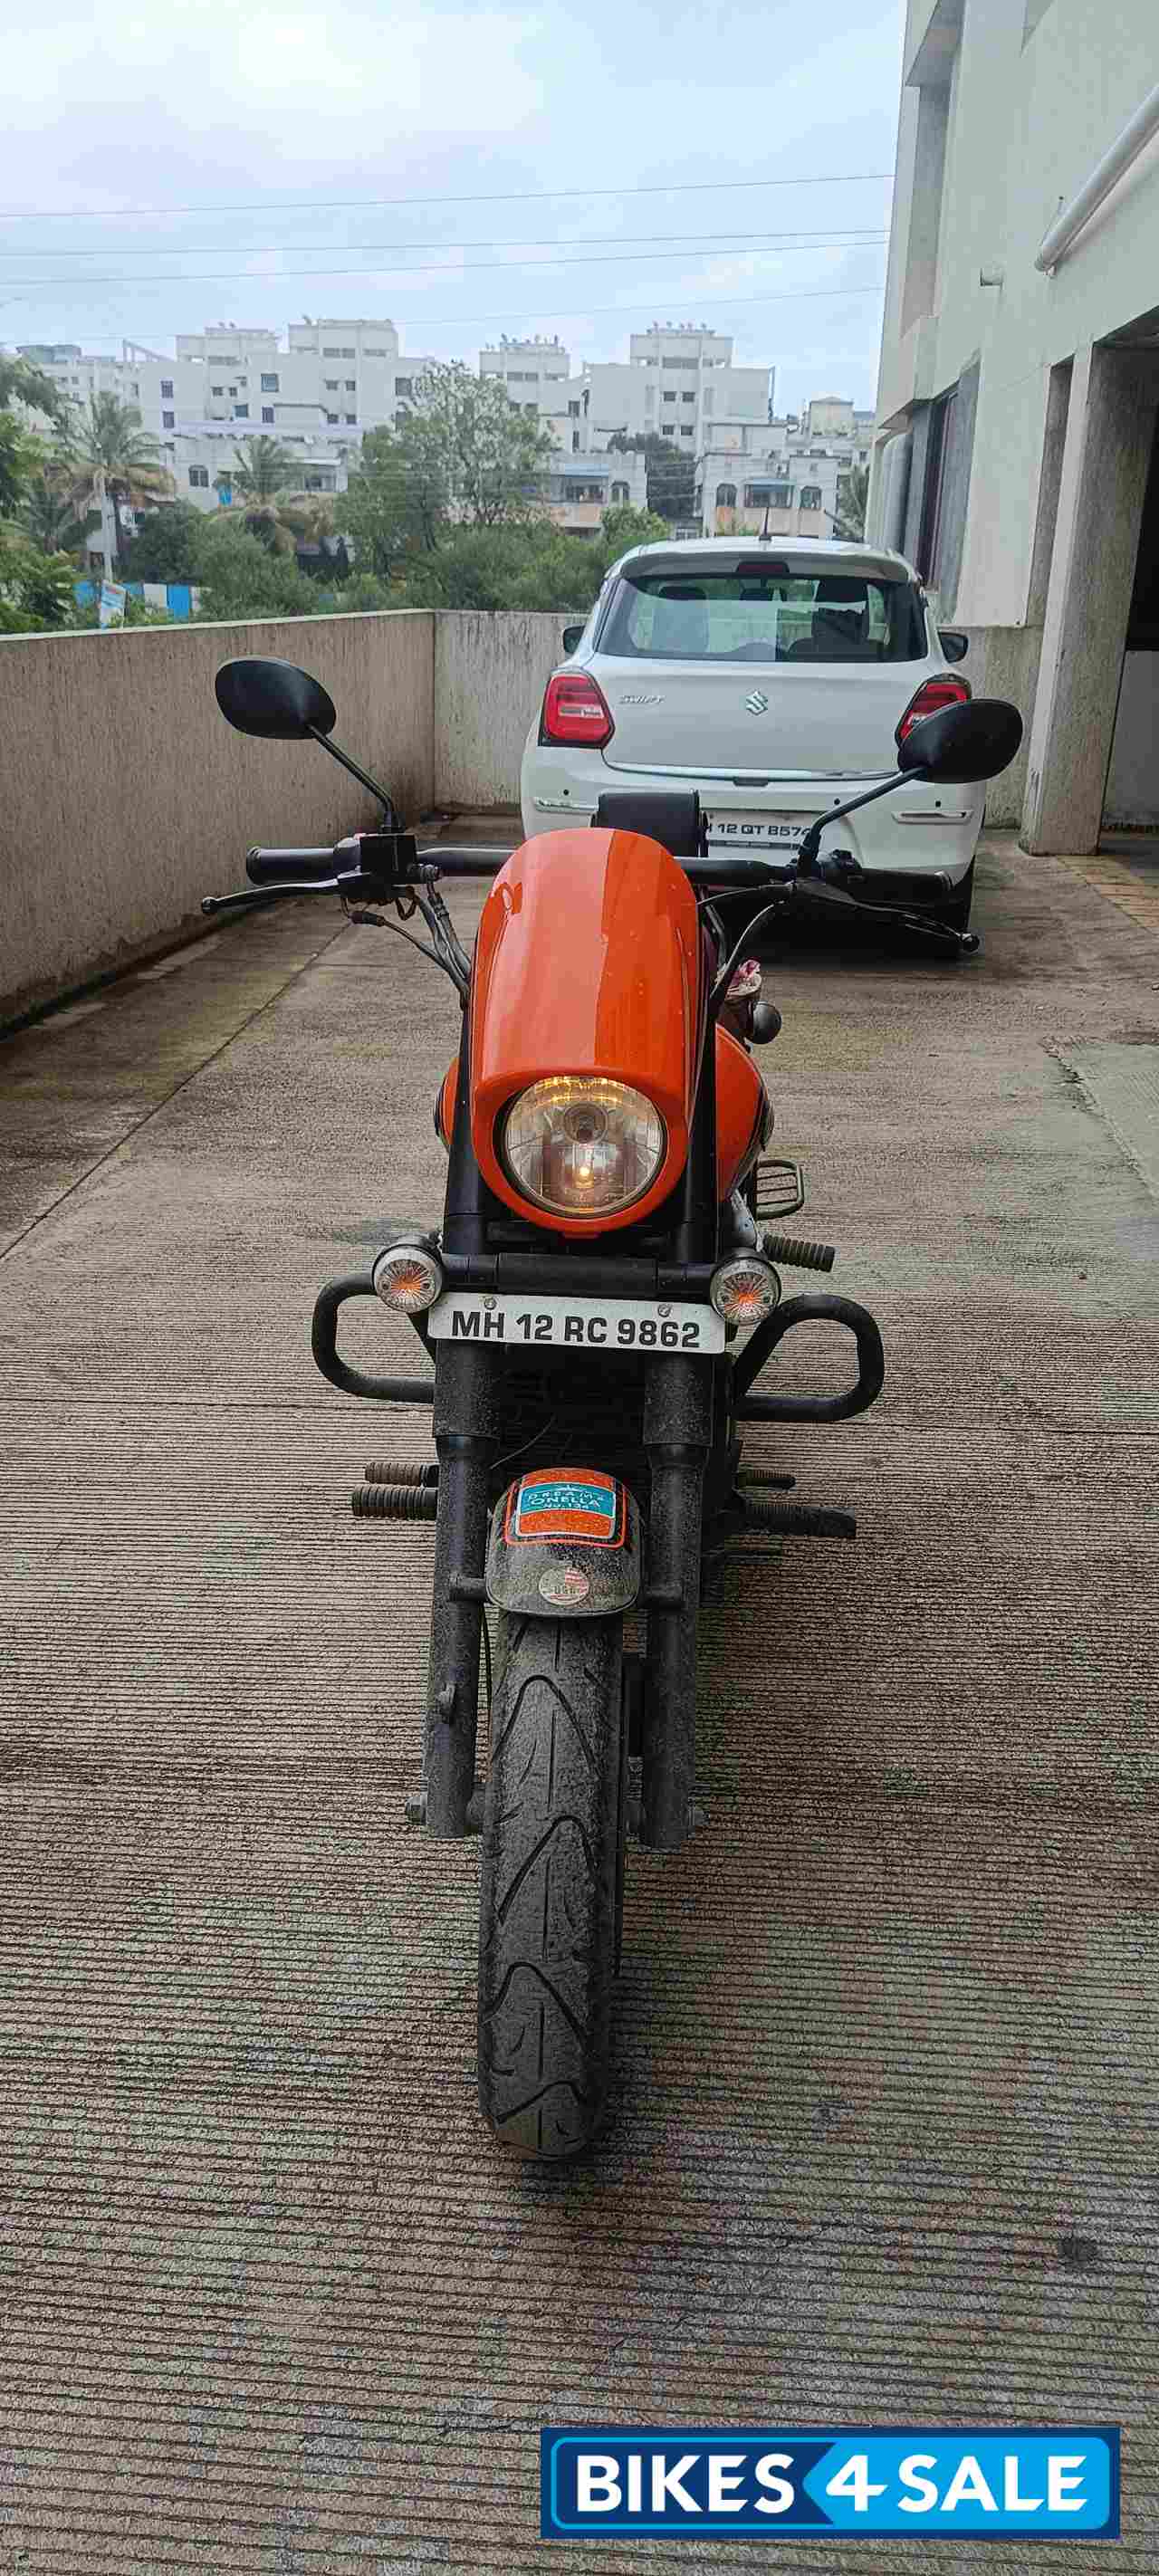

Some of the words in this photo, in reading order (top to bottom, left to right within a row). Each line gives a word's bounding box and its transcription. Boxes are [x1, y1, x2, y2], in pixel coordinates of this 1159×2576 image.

[717, 823, 737, 834] 12
[741, 825, 765, 835] QT
[451, 1310, 505, 1338] MH
[516, 1313, 553, 1341] 12
[563, 1317, 608, 1344] RC
[616, 1318, 701, 1348] 9862
